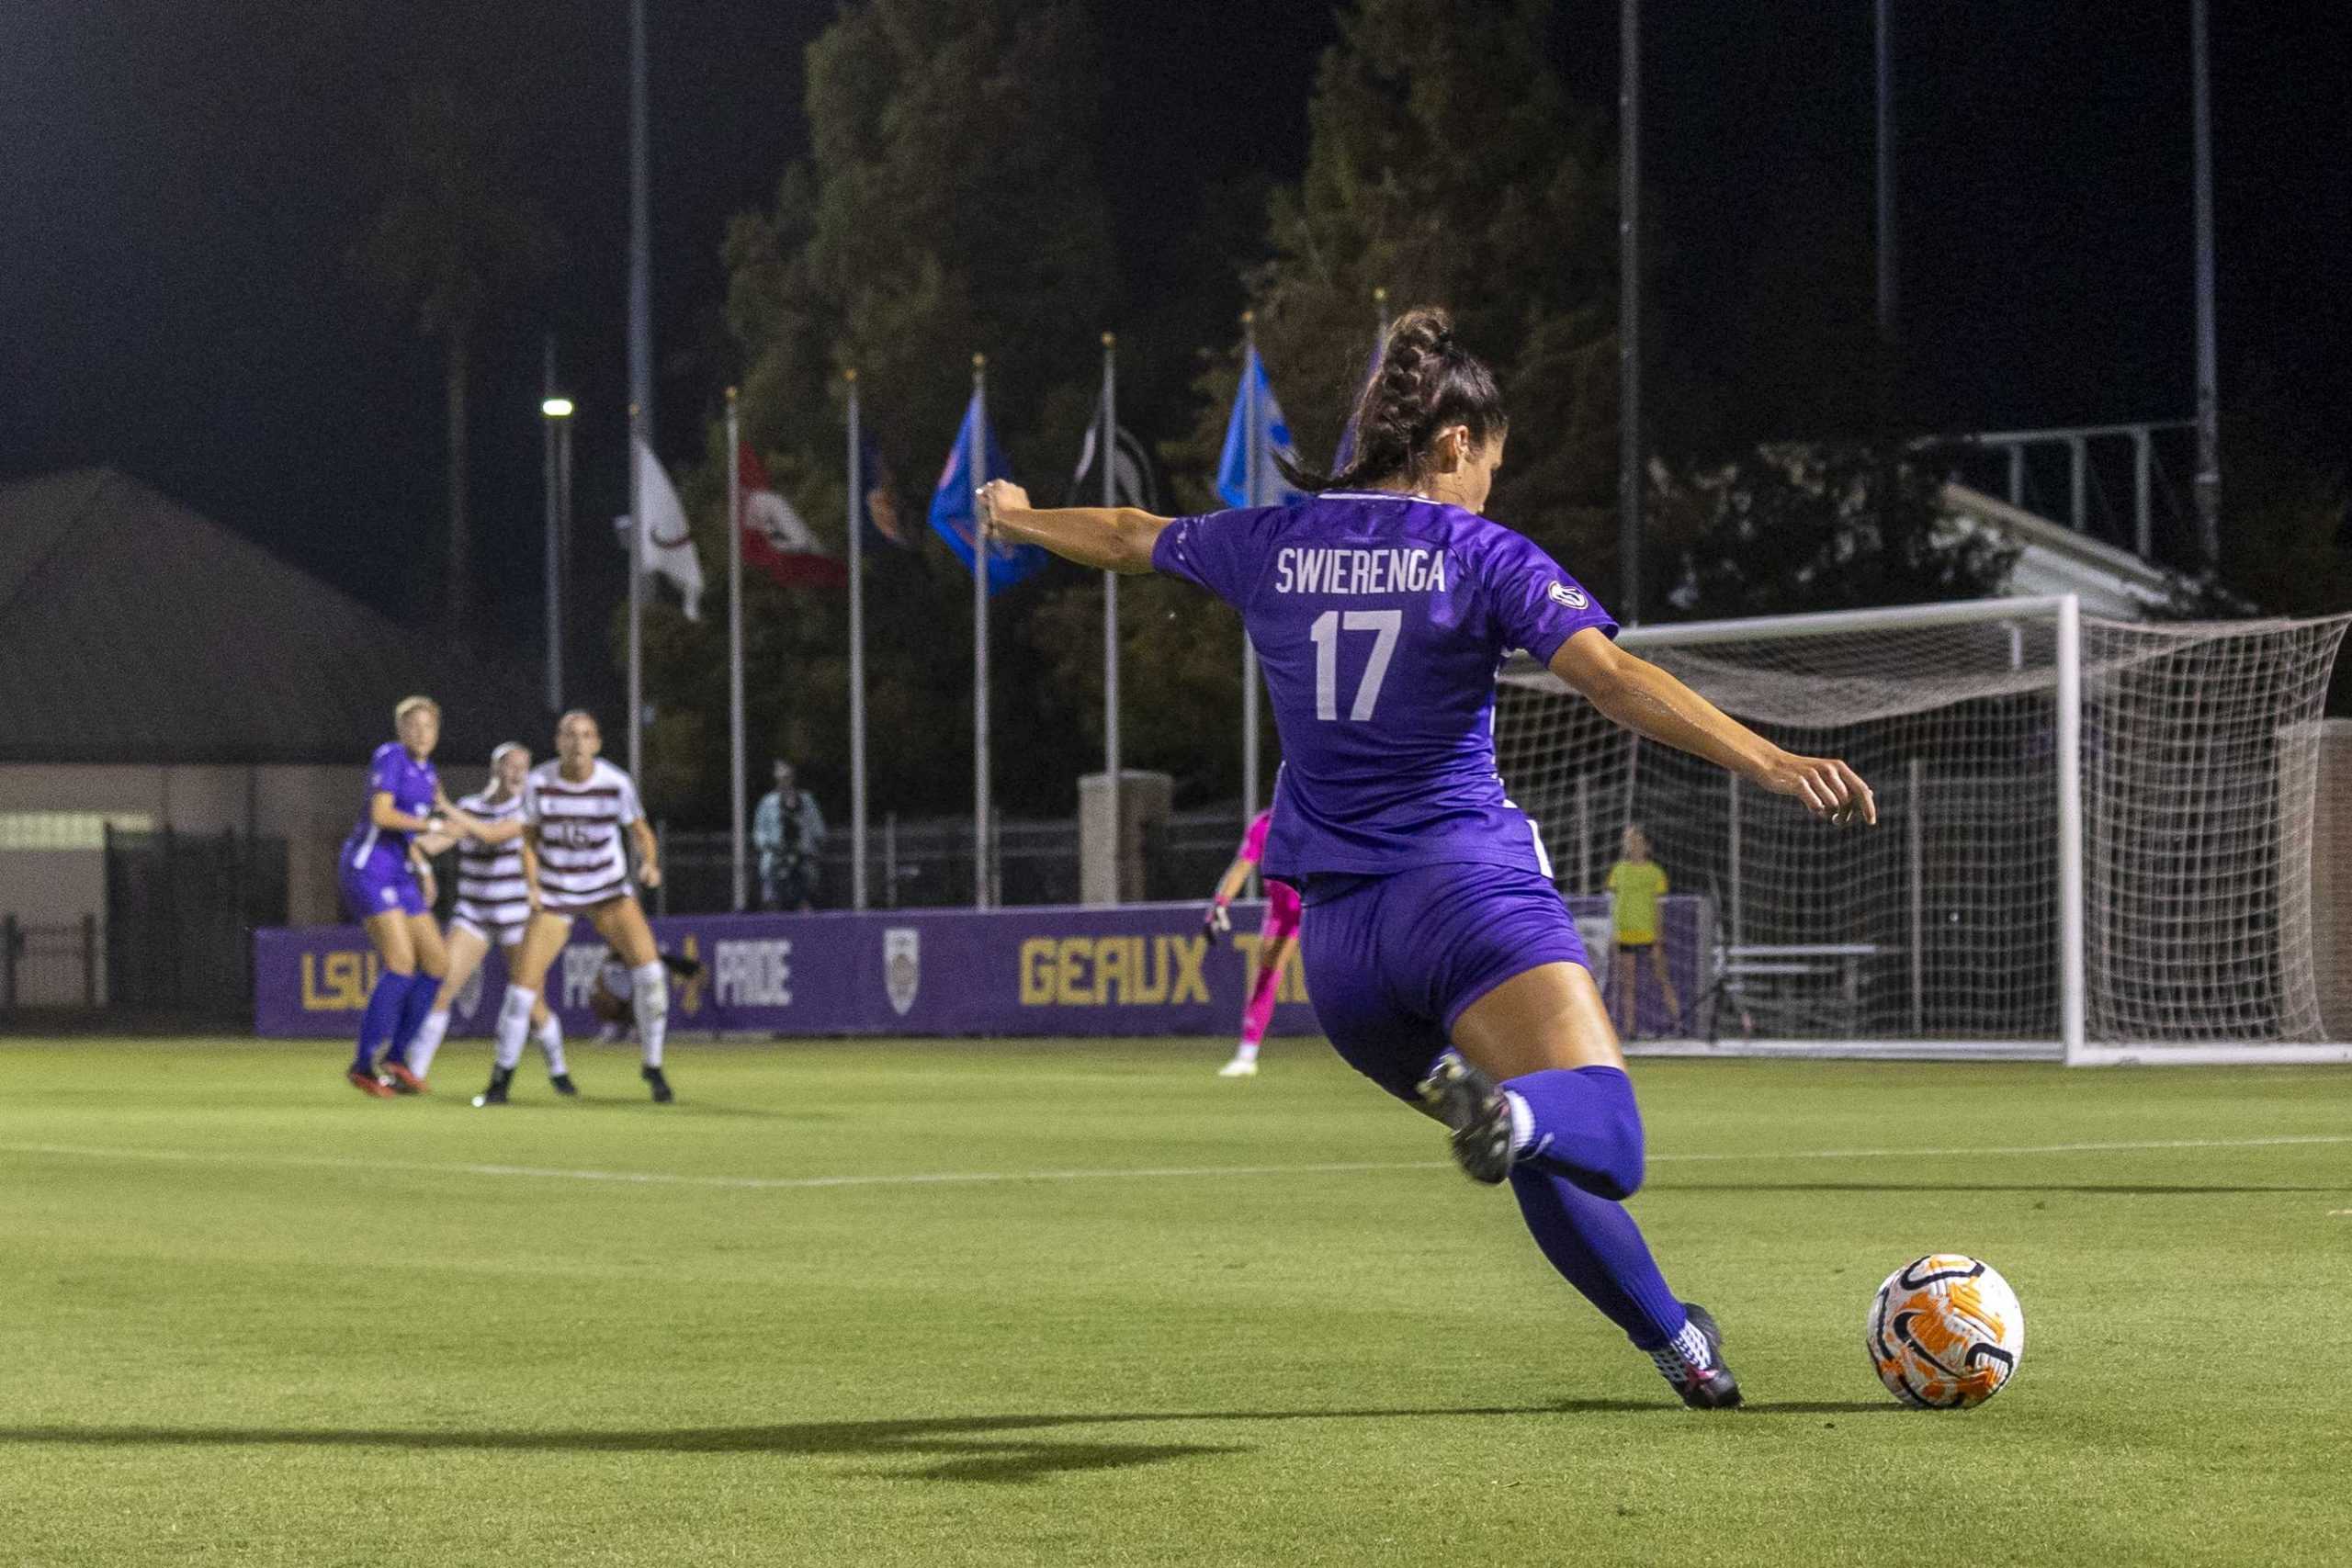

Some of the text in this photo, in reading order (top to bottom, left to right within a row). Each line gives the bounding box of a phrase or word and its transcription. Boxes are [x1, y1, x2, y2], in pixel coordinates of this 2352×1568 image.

[1274, 547, 1446, 594] SWIERENGA
[1310, 609, 1403, 722] 17
[301, 952, 379, 1011] LSU
[715, 939, 792, 1007] PRIDE
[1020, 936, 1210, 1004] GEAUX
